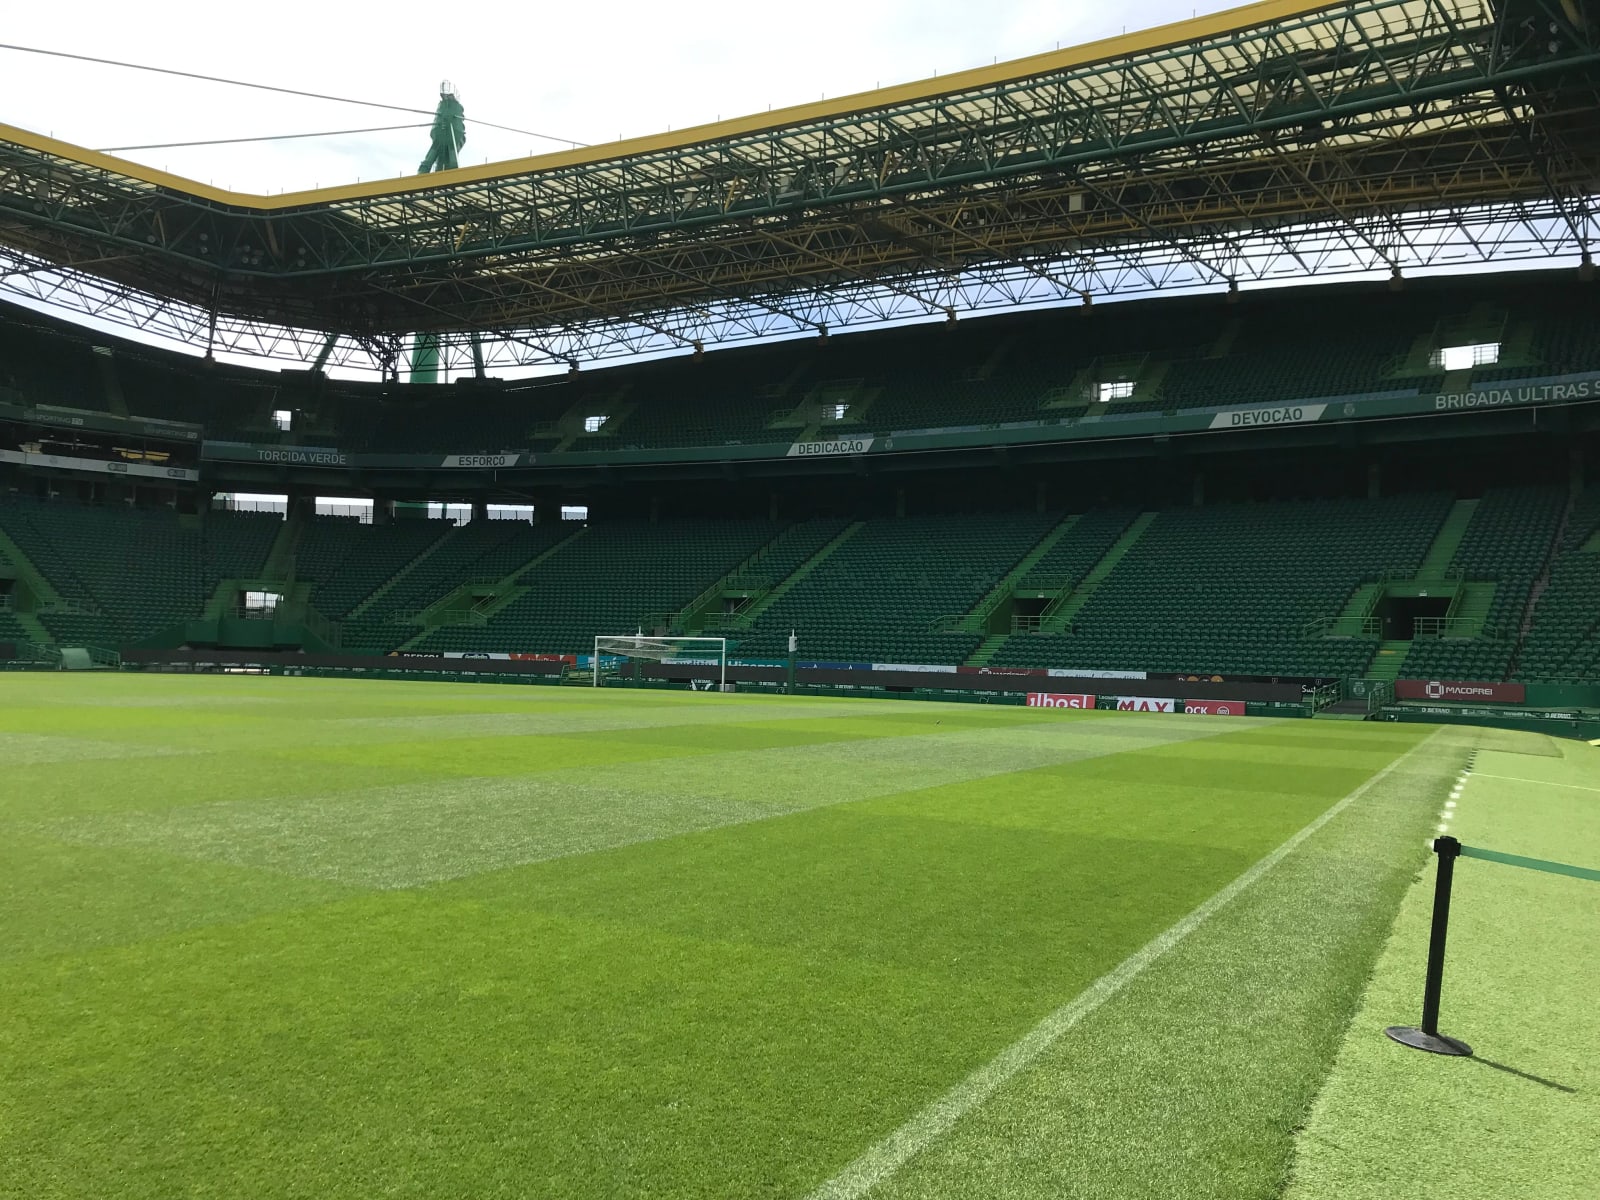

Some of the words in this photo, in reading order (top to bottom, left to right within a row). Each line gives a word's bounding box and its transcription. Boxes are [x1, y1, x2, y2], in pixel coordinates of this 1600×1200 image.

[1435, 389, 1513, 409] BRIGADA
[1518, 381, 1590, 402] ULTRAS
[257, 450, 307, 462] TORCIDA
[308, 453, 347, 464] VERDE
[1445, 686, 1493, 696] MACOFREI
